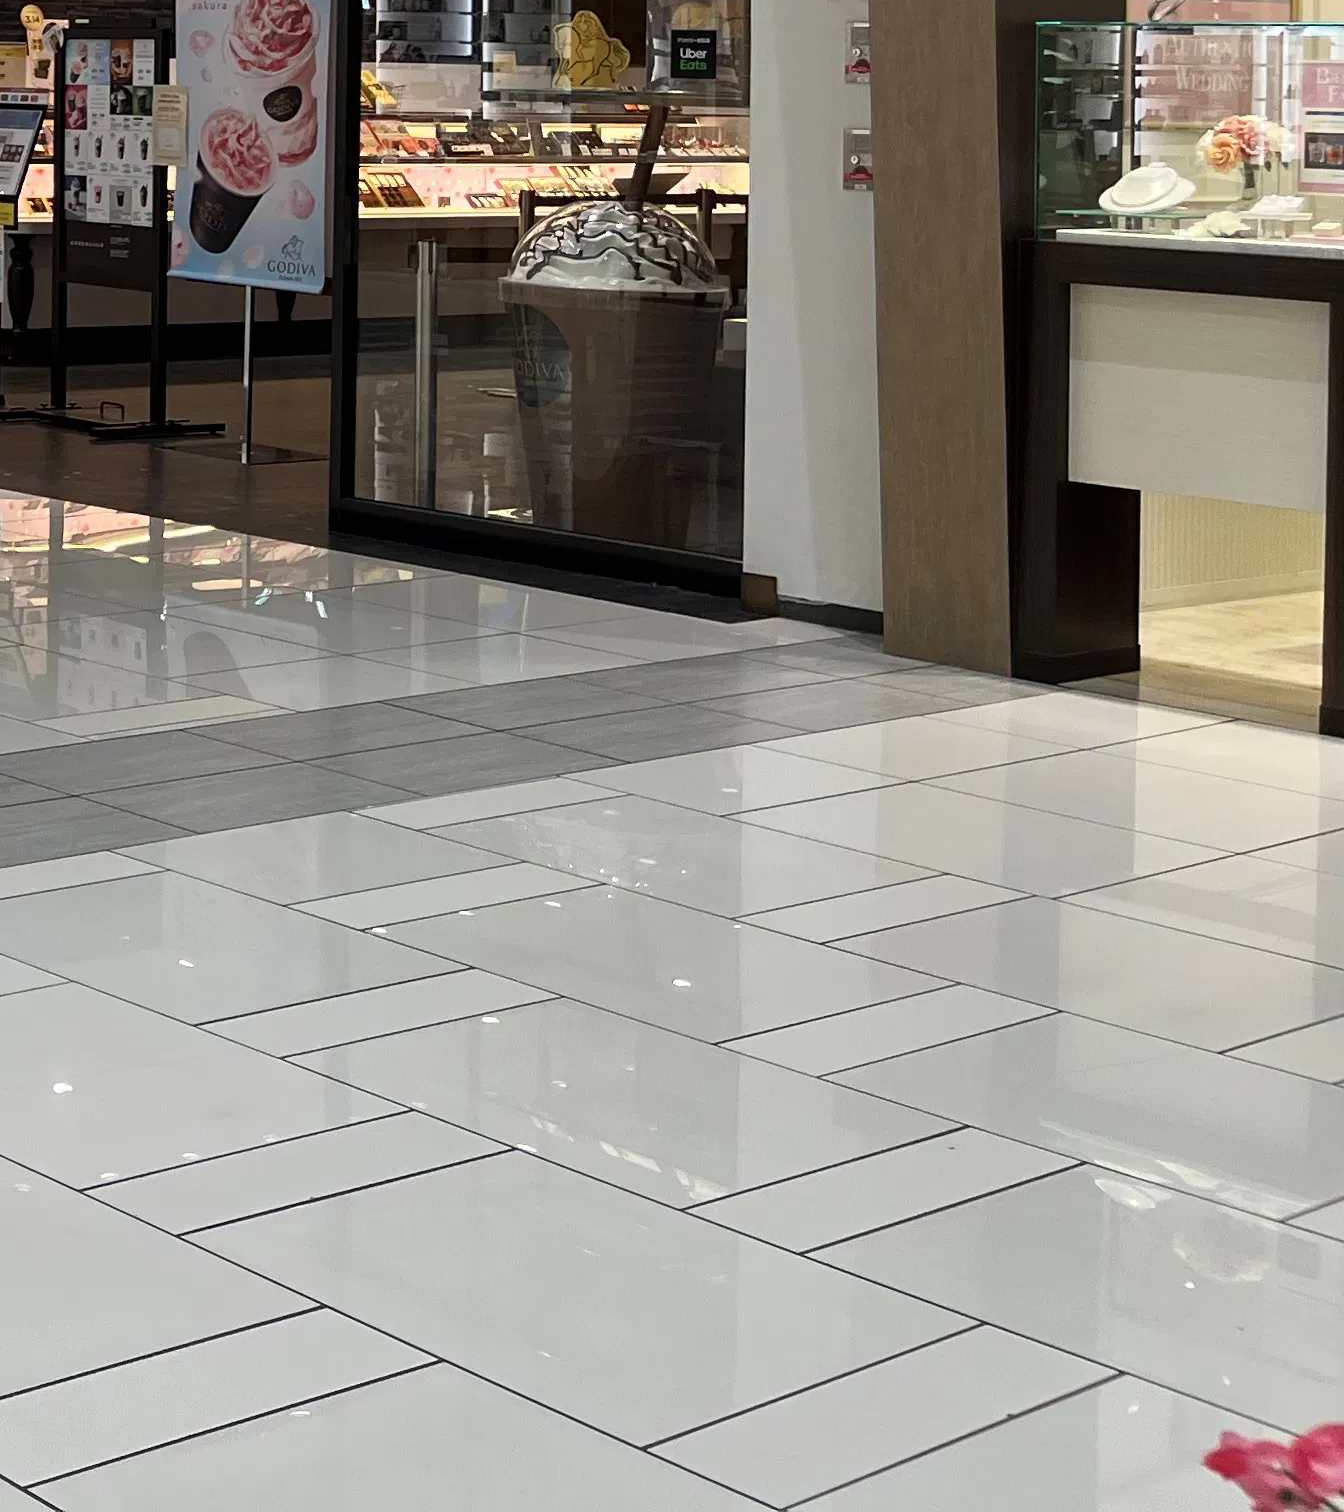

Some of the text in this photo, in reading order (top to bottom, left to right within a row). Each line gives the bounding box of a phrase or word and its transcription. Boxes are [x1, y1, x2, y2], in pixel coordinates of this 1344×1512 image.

[191, 0, 228, 10] sakura
[679, 47, 708, 59] Uber
[679, 60, 708, 71] Eats
[267, 259, 316, 277] GODIVA
